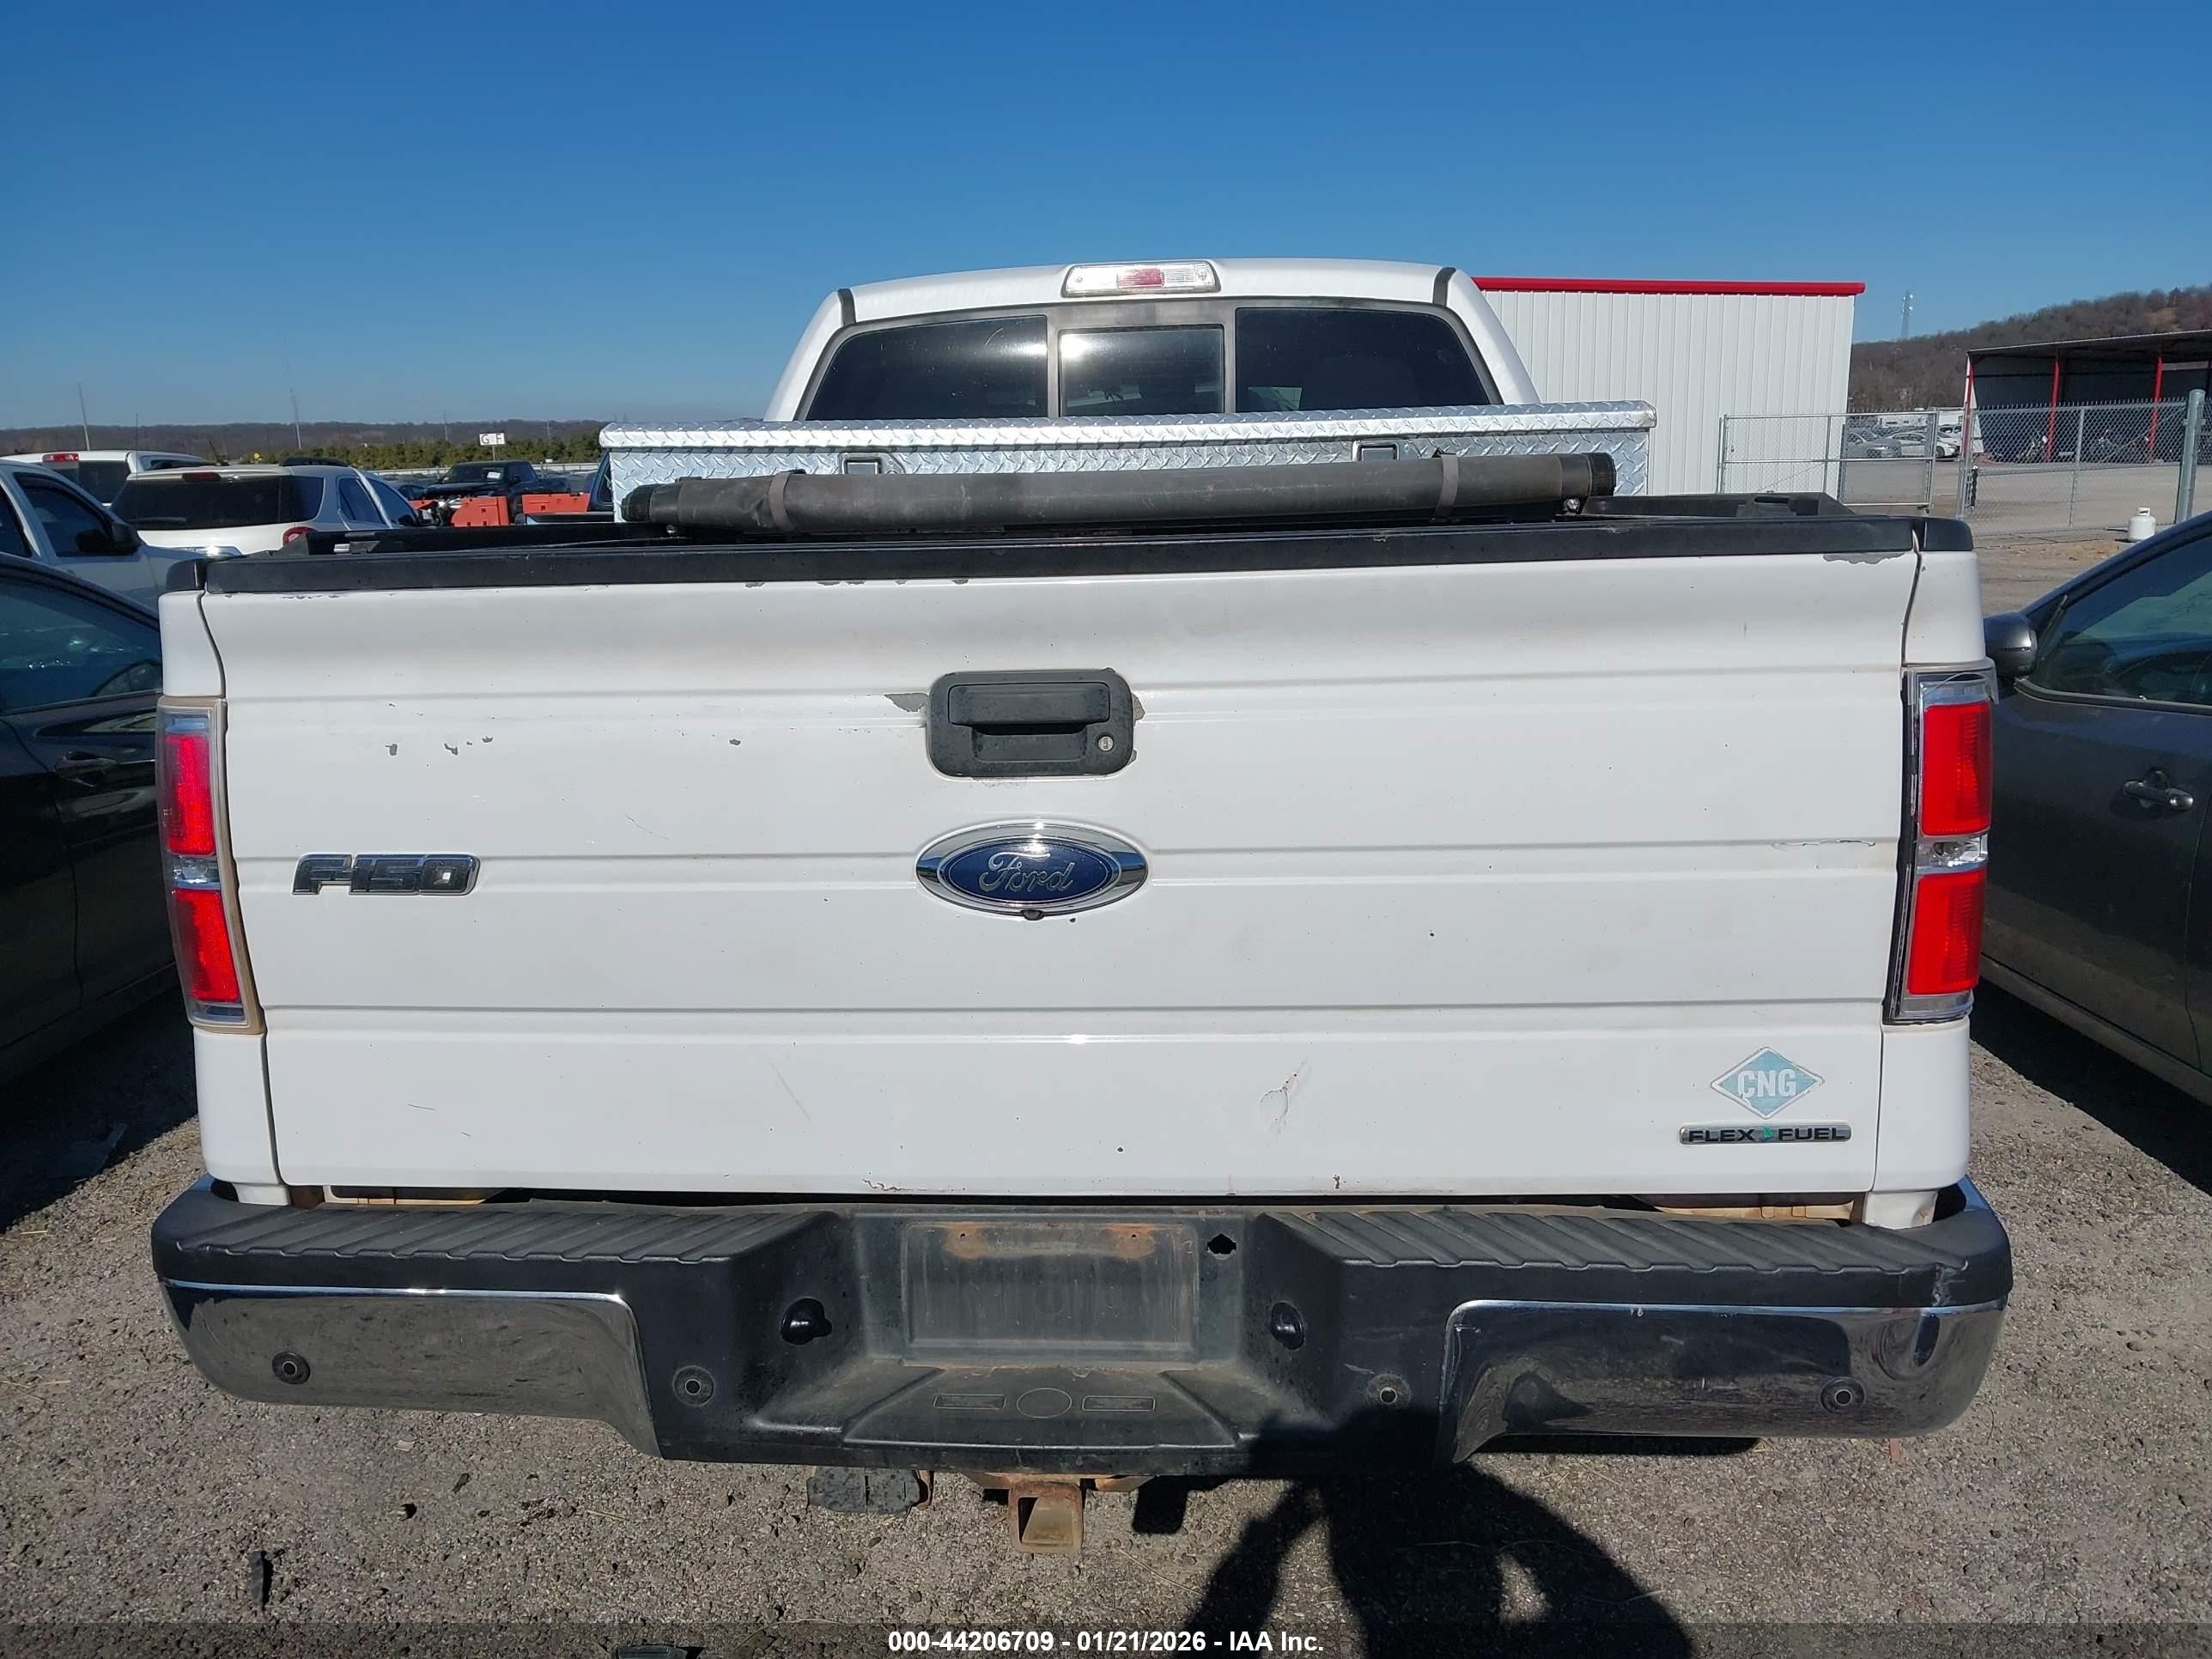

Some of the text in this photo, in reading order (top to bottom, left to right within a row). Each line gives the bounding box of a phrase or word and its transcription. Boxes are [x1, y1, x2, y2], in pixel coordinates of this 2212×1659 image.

[481, 433, 502, 444] G F
[979, 852, 1075, 892] Ford
[1737, 1069, 1796, 1097] CNG
[1688, 1127, 1846, 1142] FLEX FUEL
